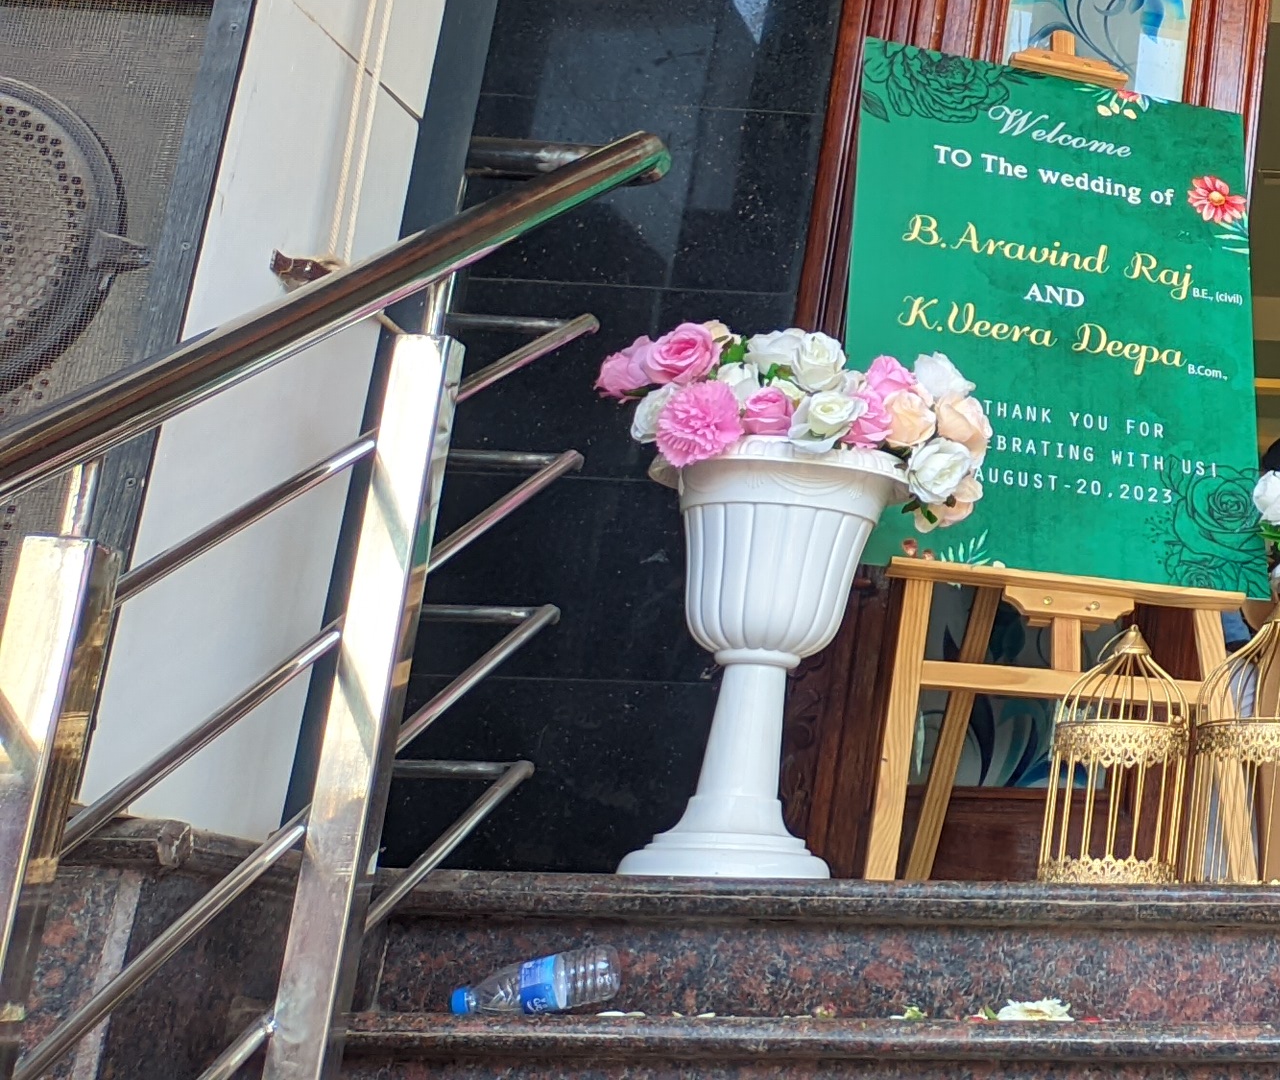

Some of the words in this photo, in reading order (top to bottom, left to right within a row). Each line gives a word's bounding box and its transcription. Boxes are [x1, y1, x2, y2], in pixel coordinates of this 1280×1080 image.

[988, 104, 1133, 158] Welcome
[934, 144, 972, 169] TO
[981, 152, 1029, 179] The
[1038, 168, 1142, 205] wedding
[1150, 187, 1175, 206] of
[1023, 282, 1085, 308] AND
[1123, 252, 1195, 301] Raj
[1215, 291, 1244, 307] (civil)
[1071, 322, 1188, 376] Deepa
[983, 399, 1052, 424] THANK
[1069, 411, 1109, 432] YOU
[1126, 419, 1165, 439] FOR
[1111, 449, 1165, 471] WITH
